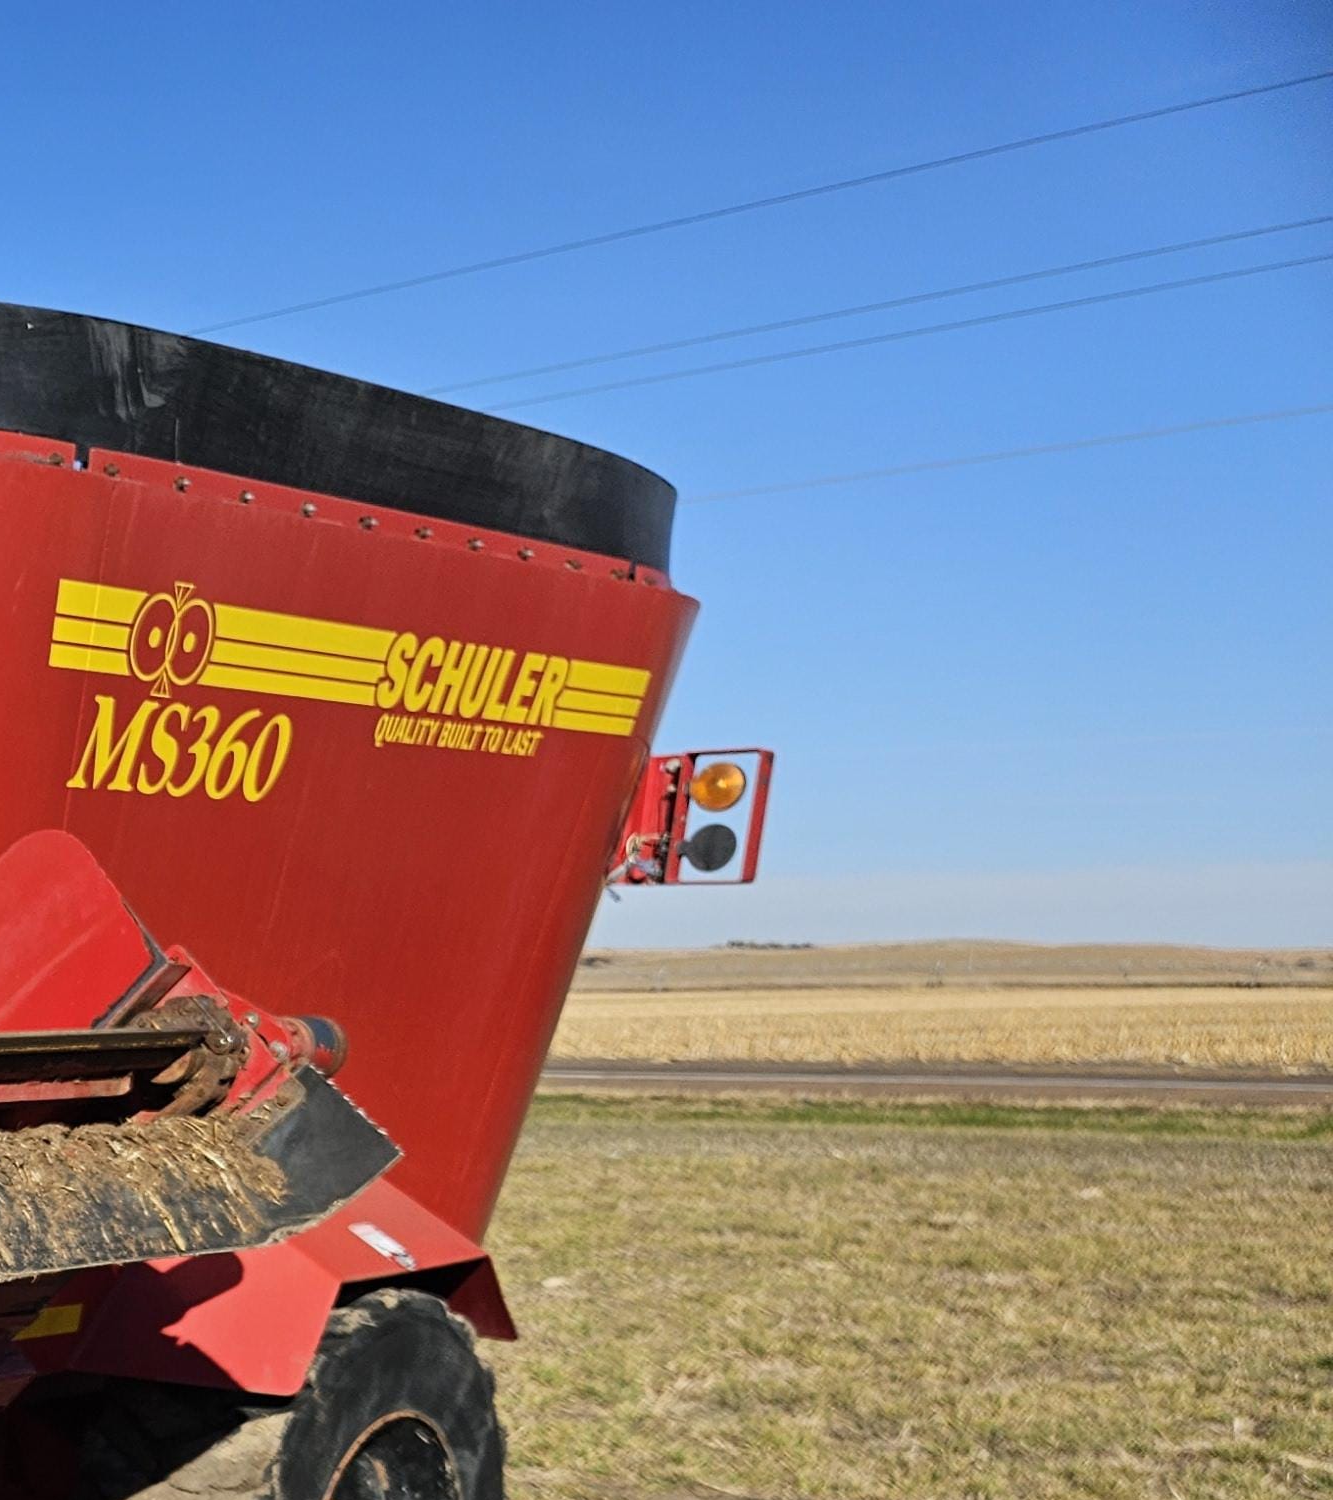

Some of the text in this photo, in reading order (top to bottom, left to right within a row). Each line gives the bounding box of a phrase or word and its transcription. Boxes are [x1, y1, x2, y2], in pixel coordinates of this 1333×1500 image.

[376, 633, 569, 727] SCHULER
[66, 694, 292, 802] MS360
[374, 713, 544, 757] QUALITY BUILT TO LAST
